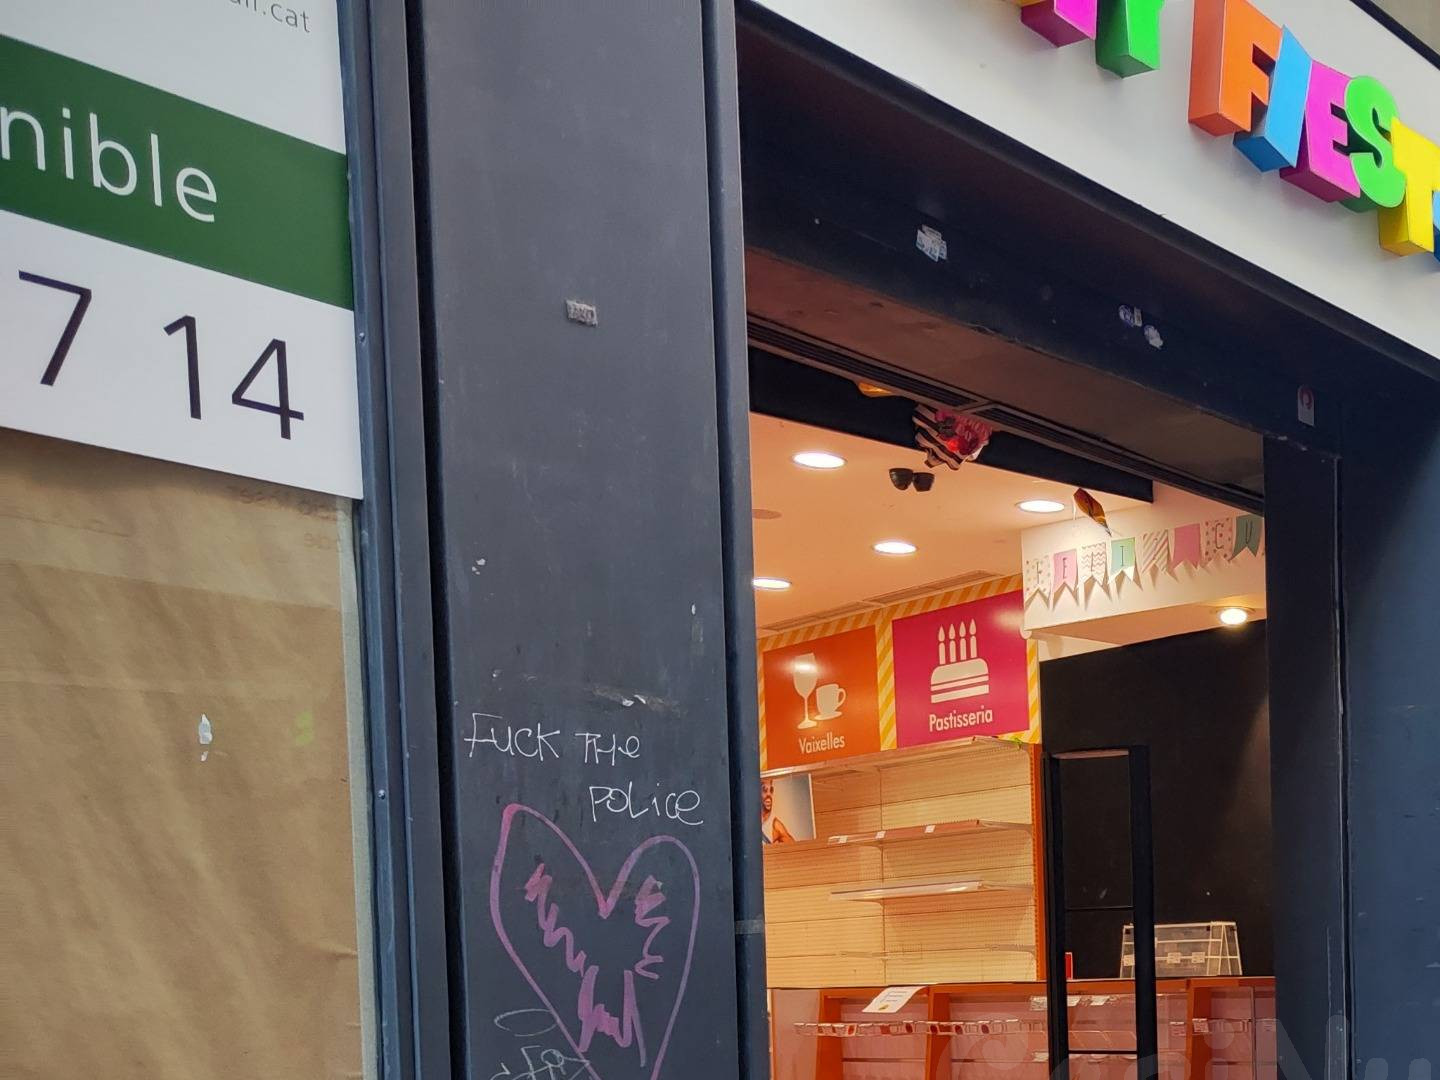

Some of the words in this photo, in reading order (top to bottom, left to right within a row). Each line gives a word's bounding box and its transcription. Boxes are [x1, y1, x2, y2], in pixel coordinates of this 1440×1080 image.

[230, 0, 310, 33] .cat
[163, 315, 304, 440] 14
[929, 705, 994, 733] Pastisseria
[464, 712, 561, 761] FUCK
[798, 732, 845, 755] Vaixelles
